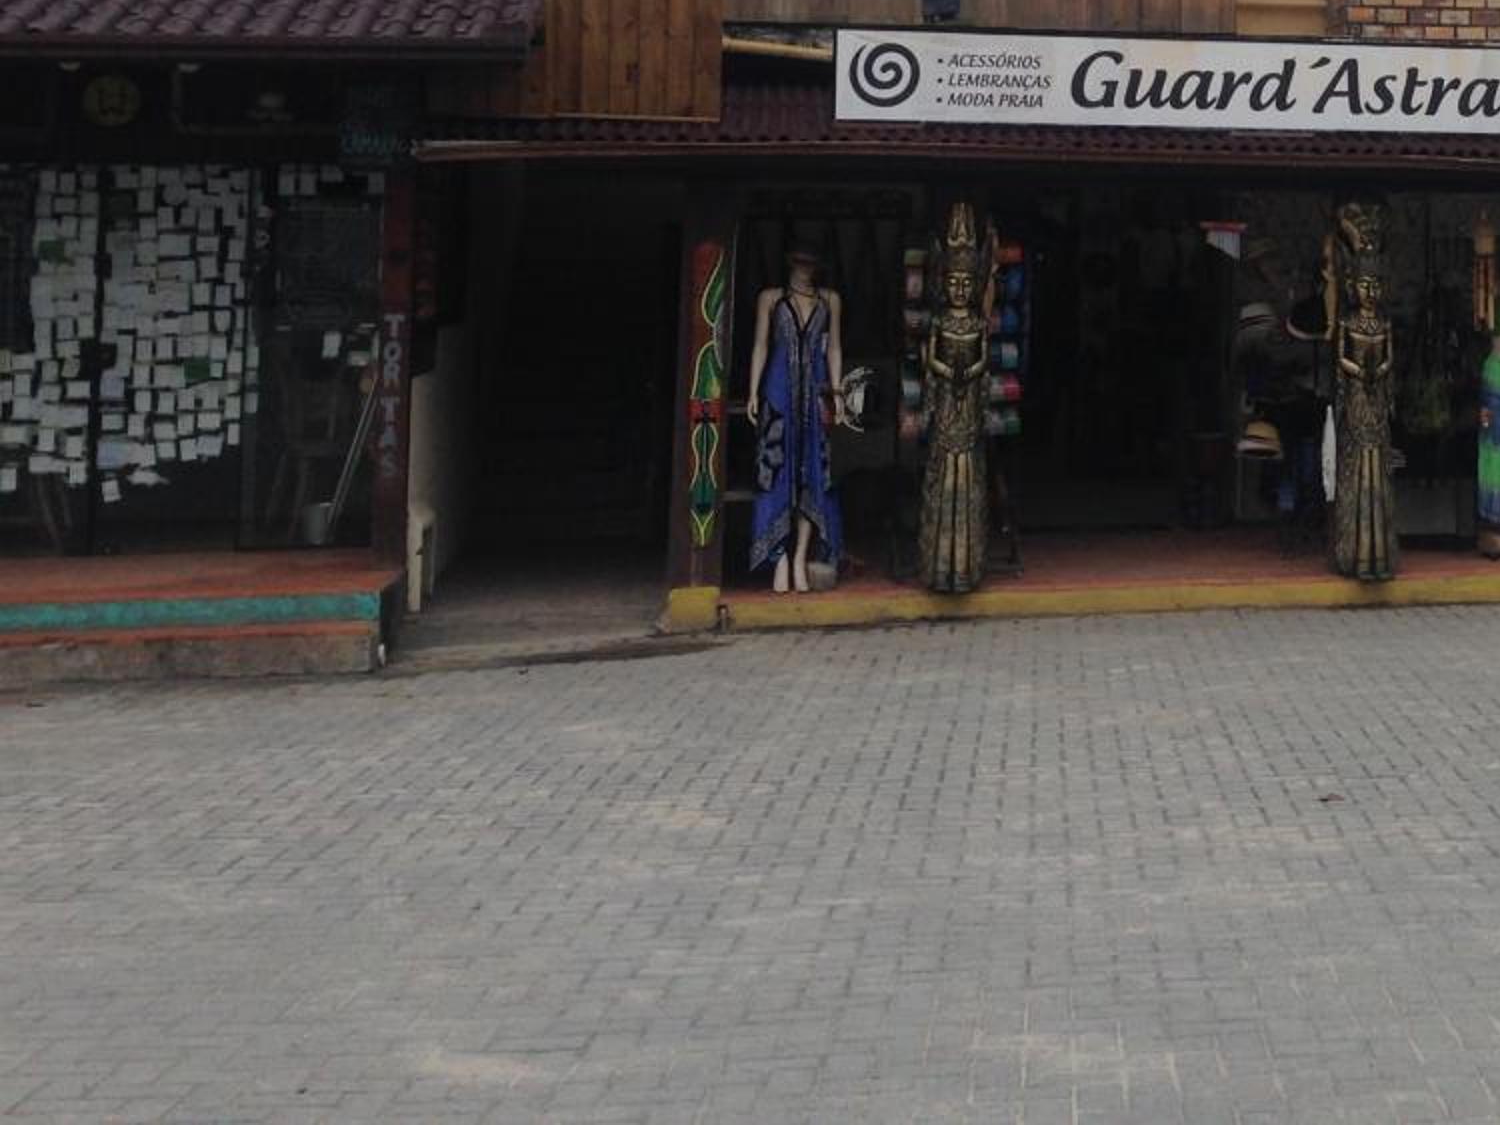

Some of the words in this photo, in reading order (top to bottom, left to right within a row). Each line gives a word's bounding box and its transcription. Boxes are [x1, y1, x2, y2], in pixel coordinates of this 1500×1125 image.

[948, 52, 1042, 69] ACESSÓRIOS
[947, 73, 1052, 91] LEMBRANÇAS
[947, 92, 996, 108] MODA
[999, 92, 1044, 109] PRAIA
